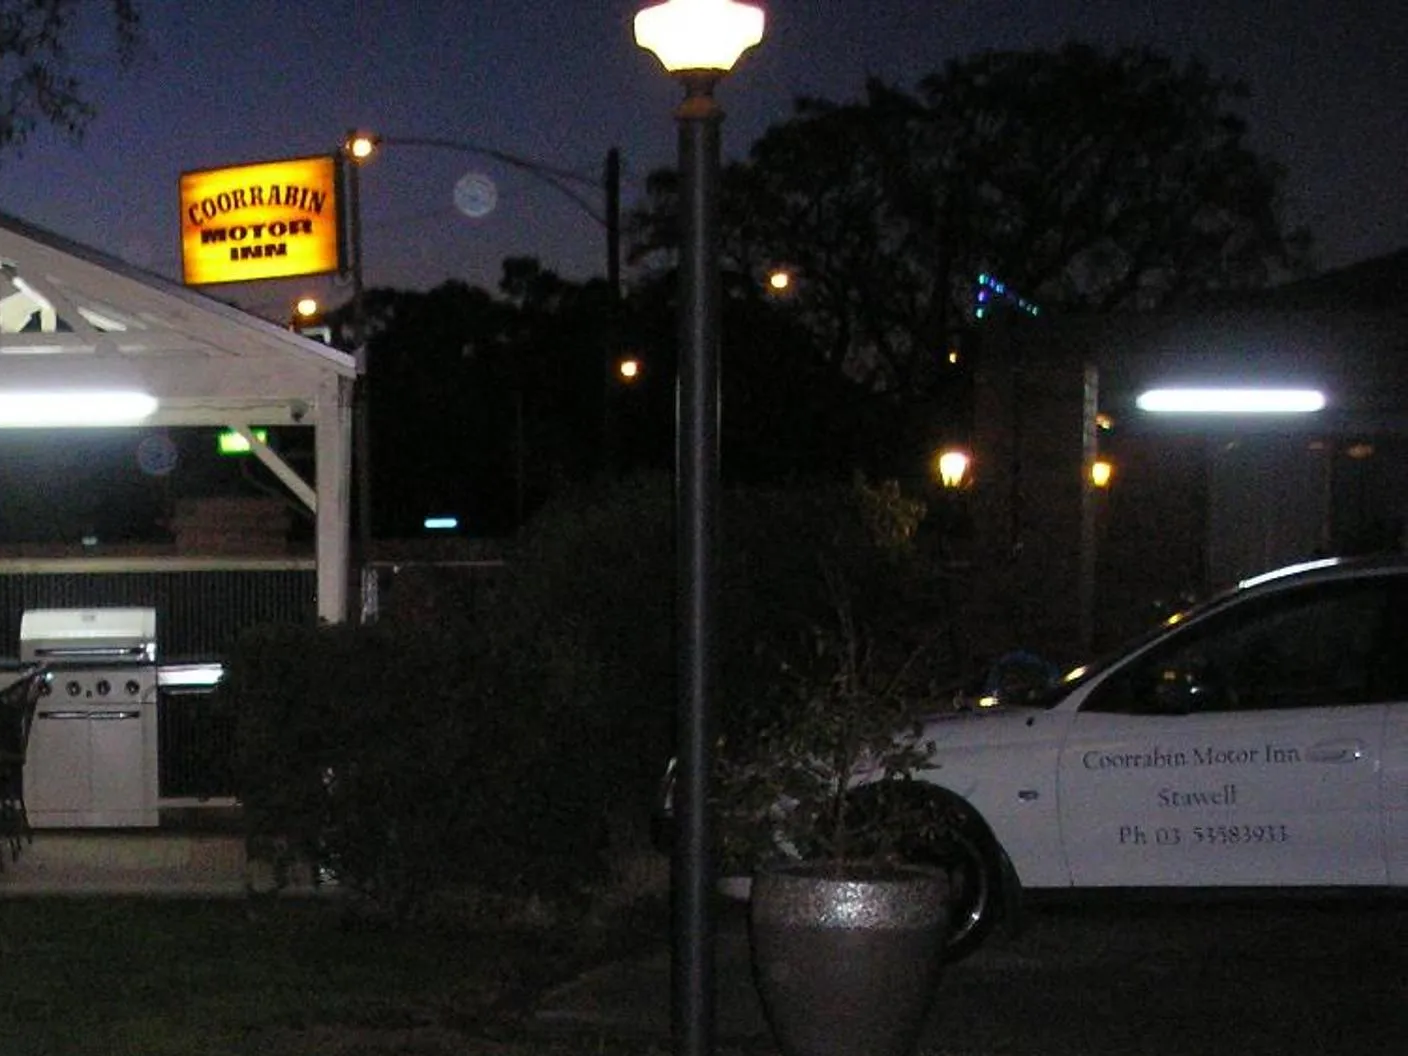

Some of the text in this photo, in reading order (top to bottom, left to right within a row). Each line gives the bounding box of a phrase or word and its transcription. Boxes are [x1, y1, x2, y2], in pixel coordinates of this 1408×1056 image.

[188, 184, 327, 227] COORRABIN
[200, 218, 312, 245] MOTOR
[230, 242, 287, 262] INN
[1082, 744, 1301, 770] Coorrabin Motor Inn
[1158, 784, 1238, 807] Stawell
[1119, 825, 1147, 845] Ph
